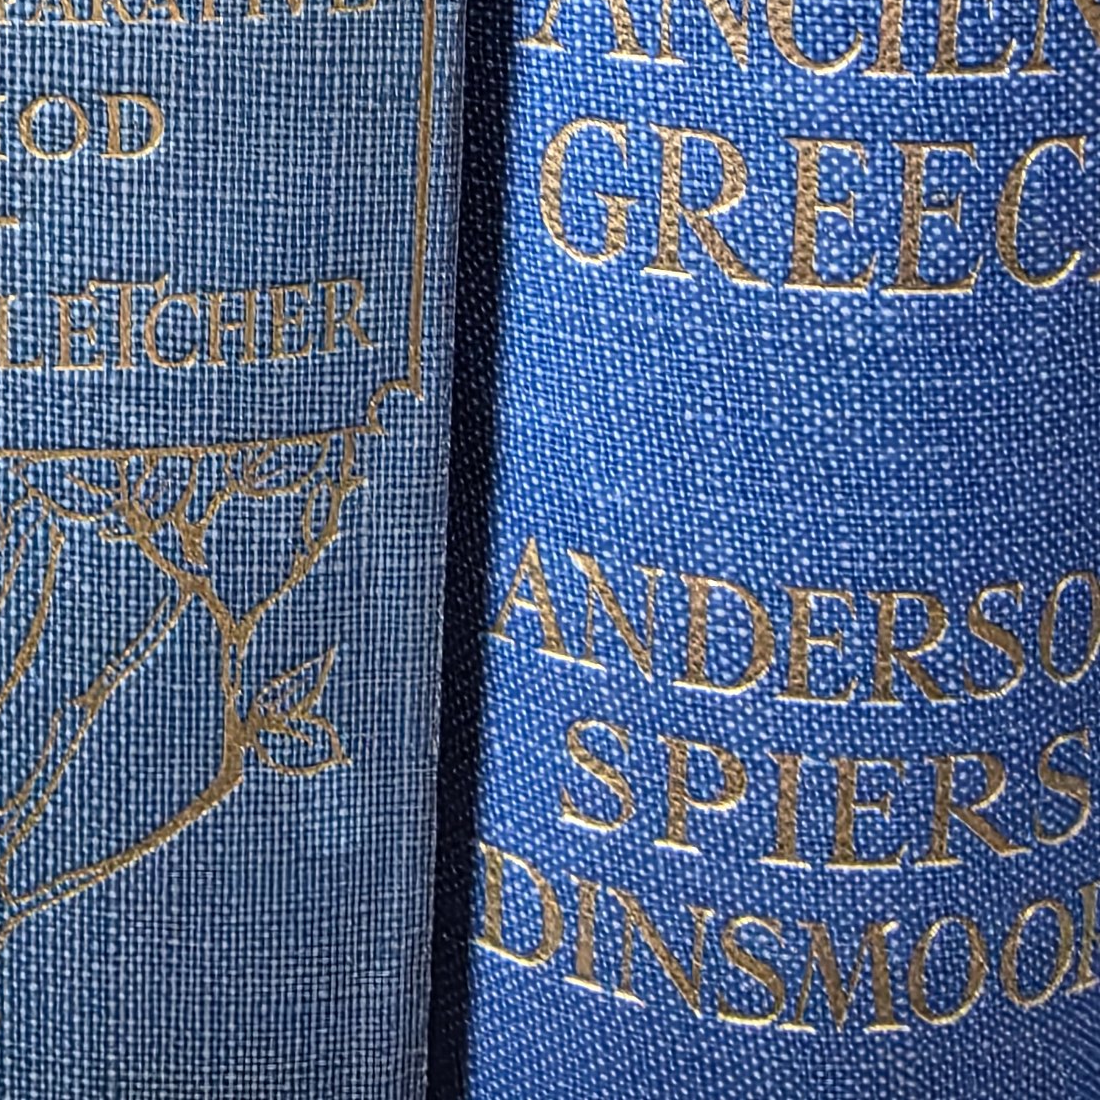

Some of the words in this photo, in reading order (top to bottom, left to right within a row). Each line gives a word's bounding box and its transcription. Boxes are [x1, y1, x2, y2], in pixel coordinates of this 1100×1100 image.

[537, 114, 1100, 298] GREEC
[480, 535, 1100, 706] ANDERSO
[558, 719, 1092, 871] SPIERS
